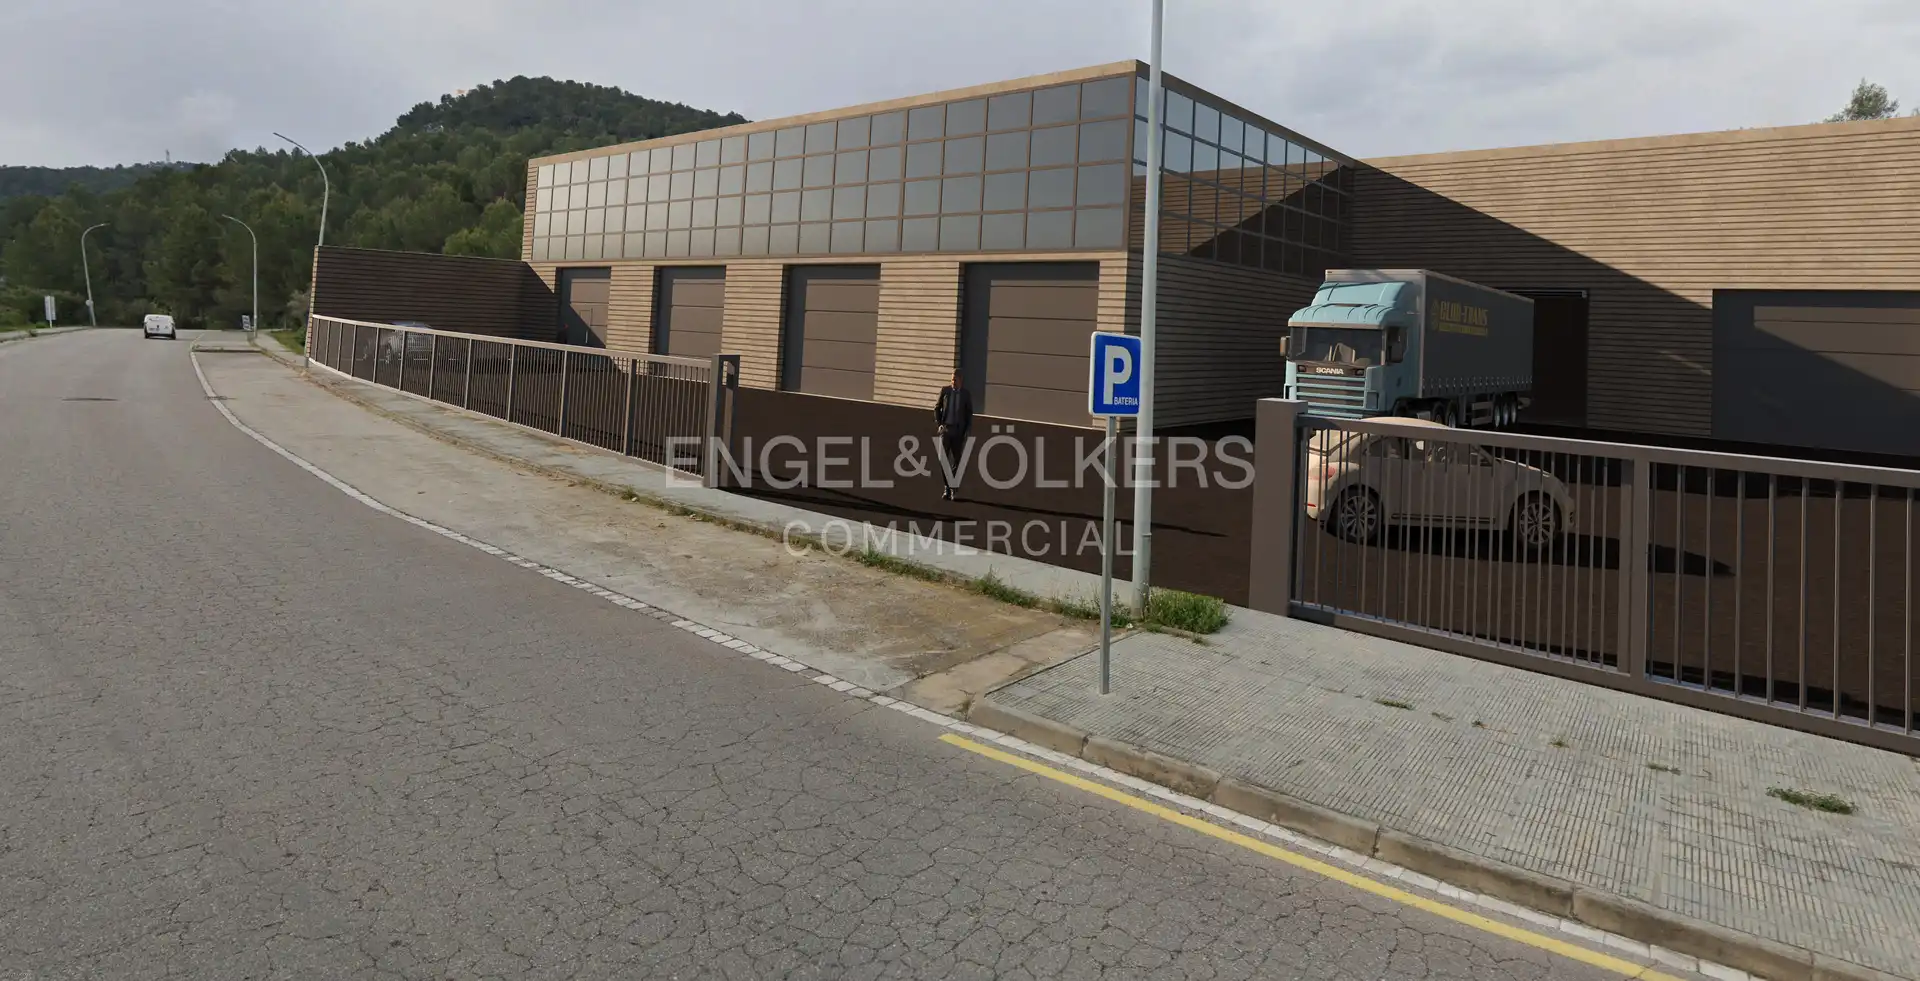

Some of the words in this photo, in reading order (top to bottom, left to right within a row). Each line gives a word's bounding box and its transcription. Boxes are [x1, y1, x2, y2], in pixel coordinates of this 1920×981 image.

[1103, 345, 1132, 404] P
[1316, 367, 1344, 375] SCANIA
[1114, 396, 1138, 405] BATERIA
